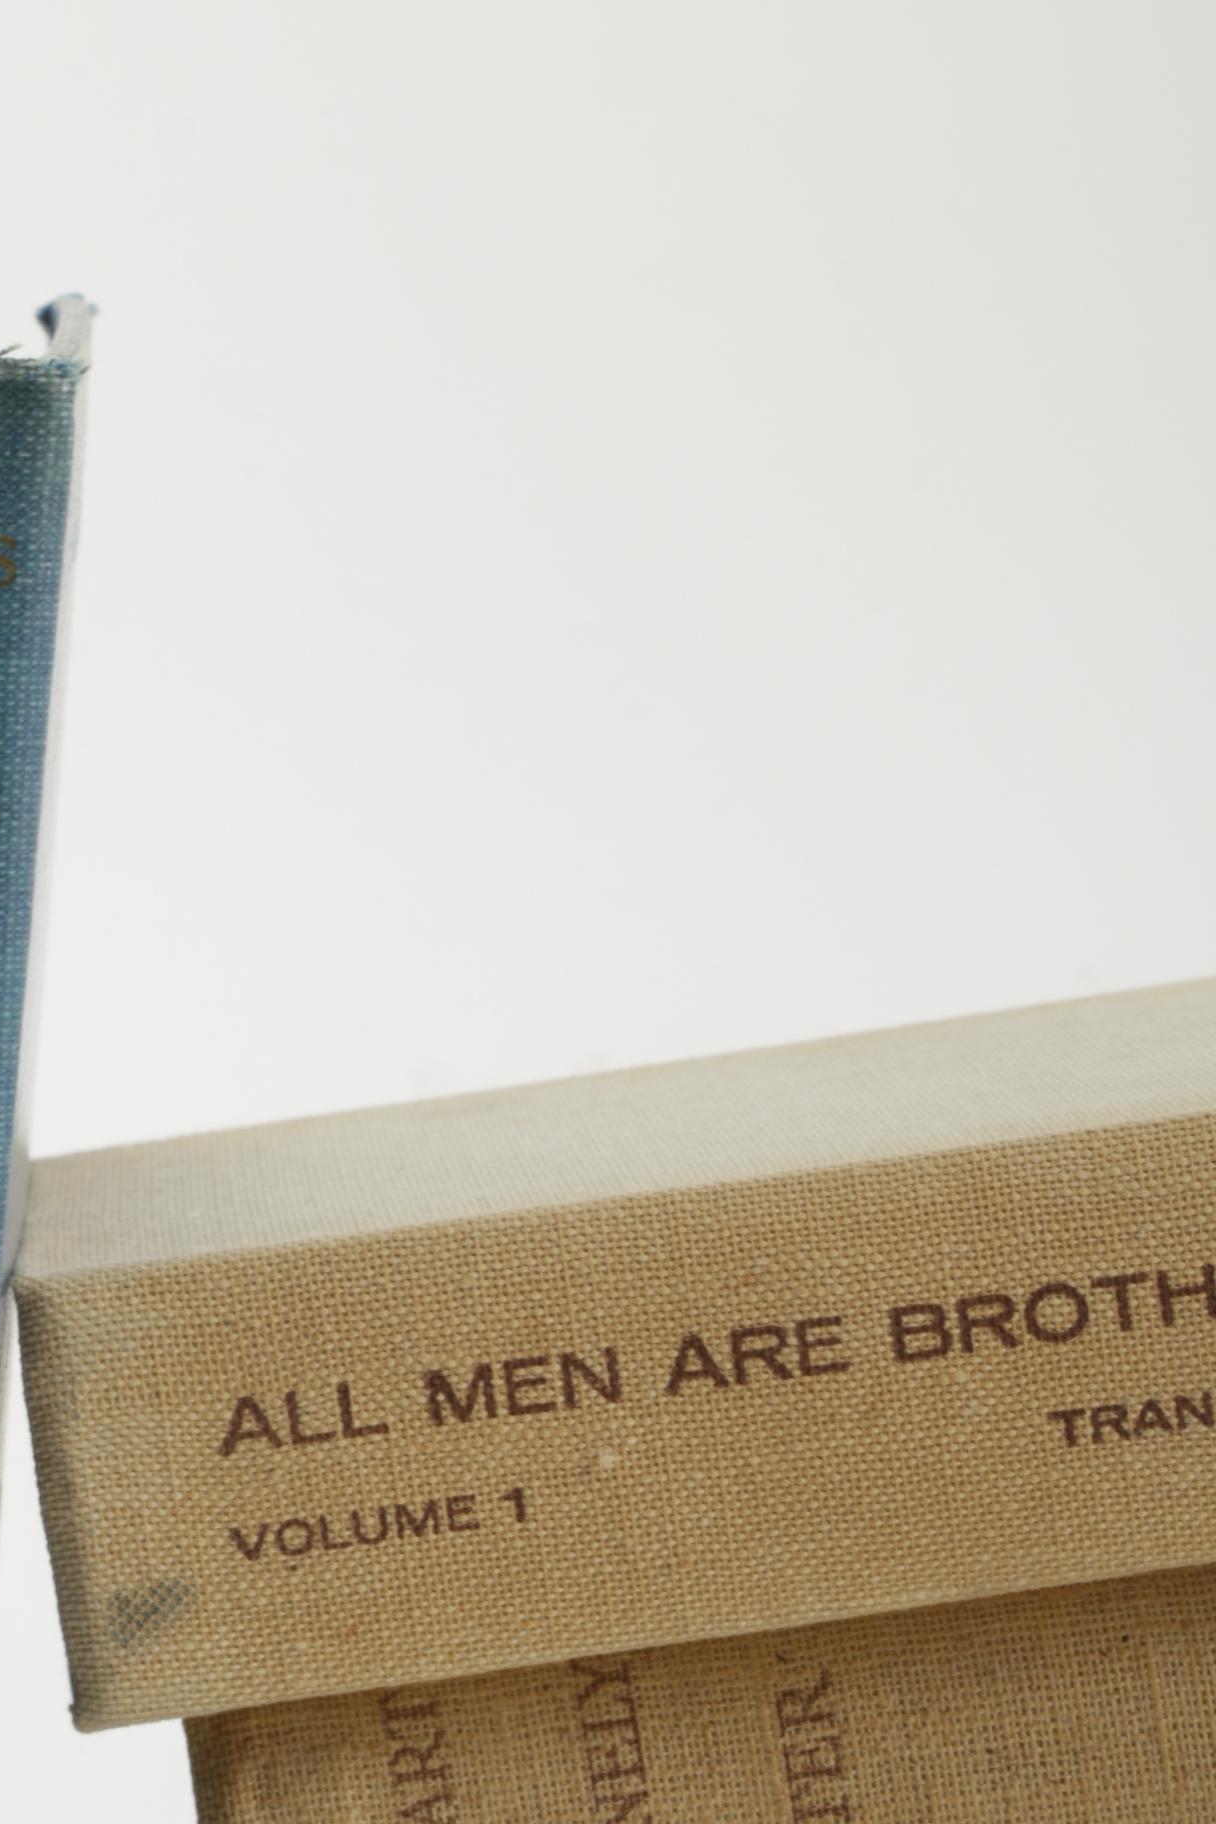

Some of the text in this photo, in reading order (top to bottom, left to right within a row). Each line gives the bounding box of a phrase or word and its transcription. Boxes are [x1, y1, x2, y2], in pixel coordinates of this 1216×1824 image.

[218, 1381, 386, 1457] ALL
[423, 1346, 622, 1428] MEN
[666, 1315, 851, 1396] ARE
[228, 1486, 530, 1562] VOLUME 1
